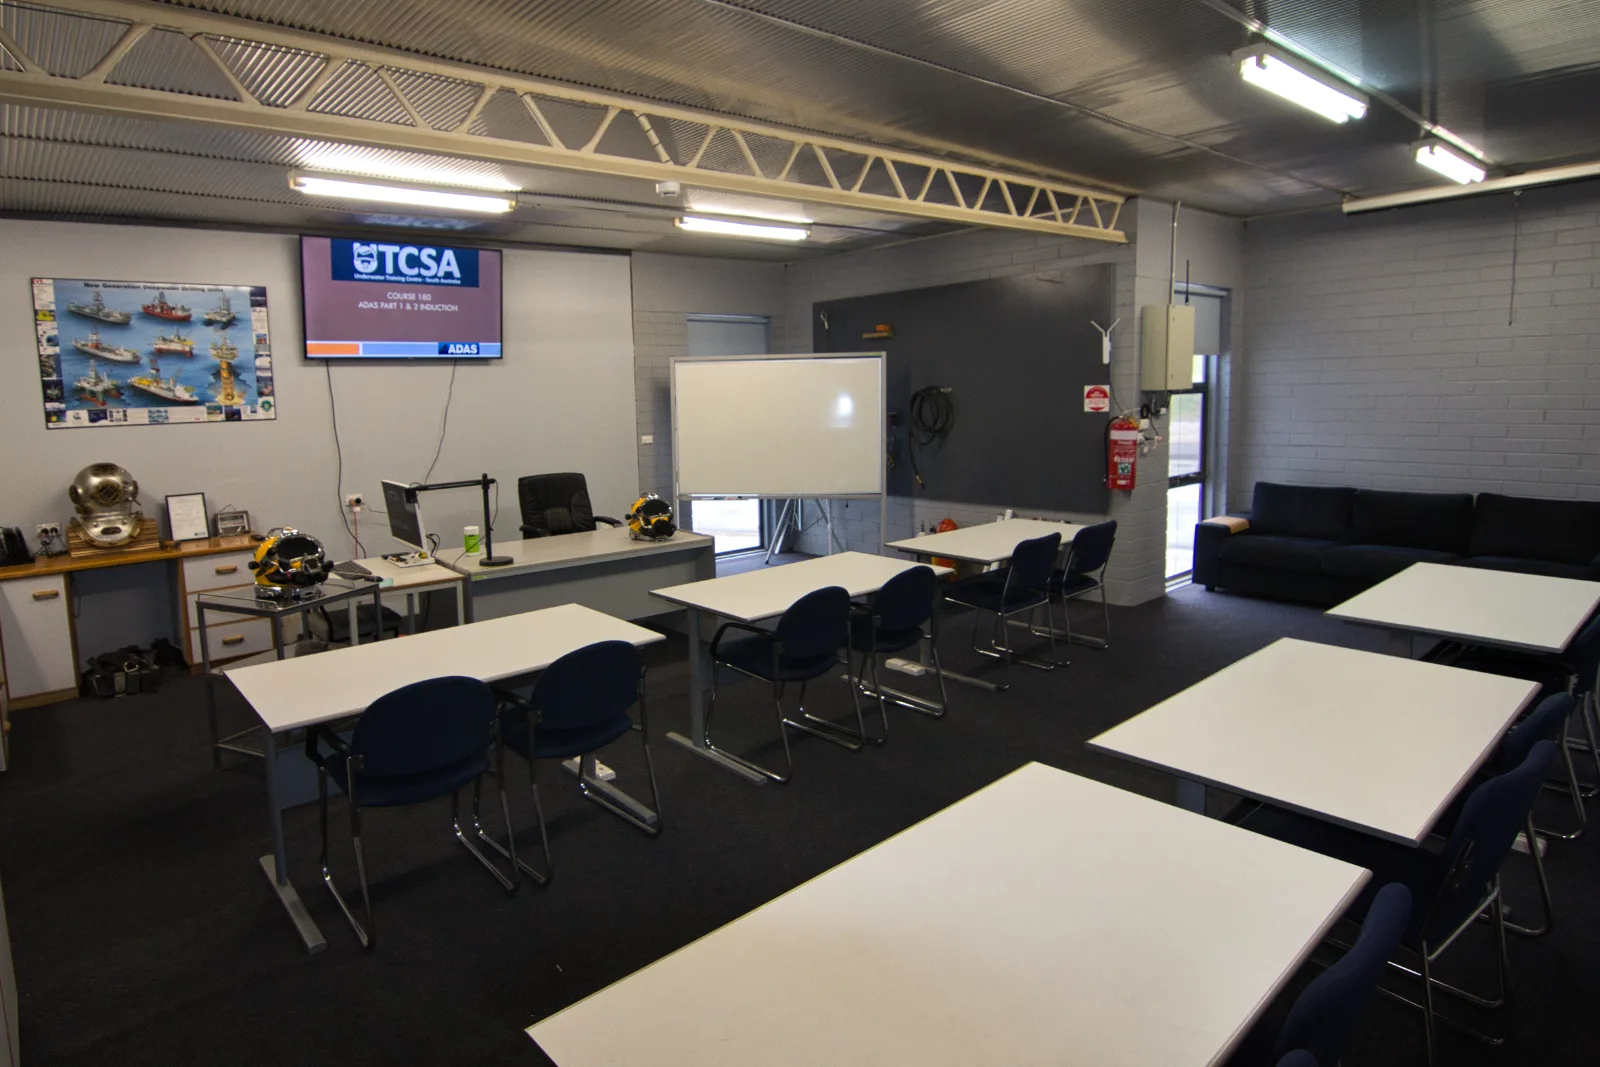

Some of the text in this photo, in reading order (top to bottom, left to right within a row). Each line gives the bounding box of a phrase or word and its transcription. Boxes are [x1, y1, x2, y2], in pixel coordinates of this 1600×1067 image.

[387, 292, 416, 300] COURSE
[358, 302, 378, 310] ADAS
[420, 304, 458, 312] INDUCTION
[448, 344, 478, 354] ADAS
